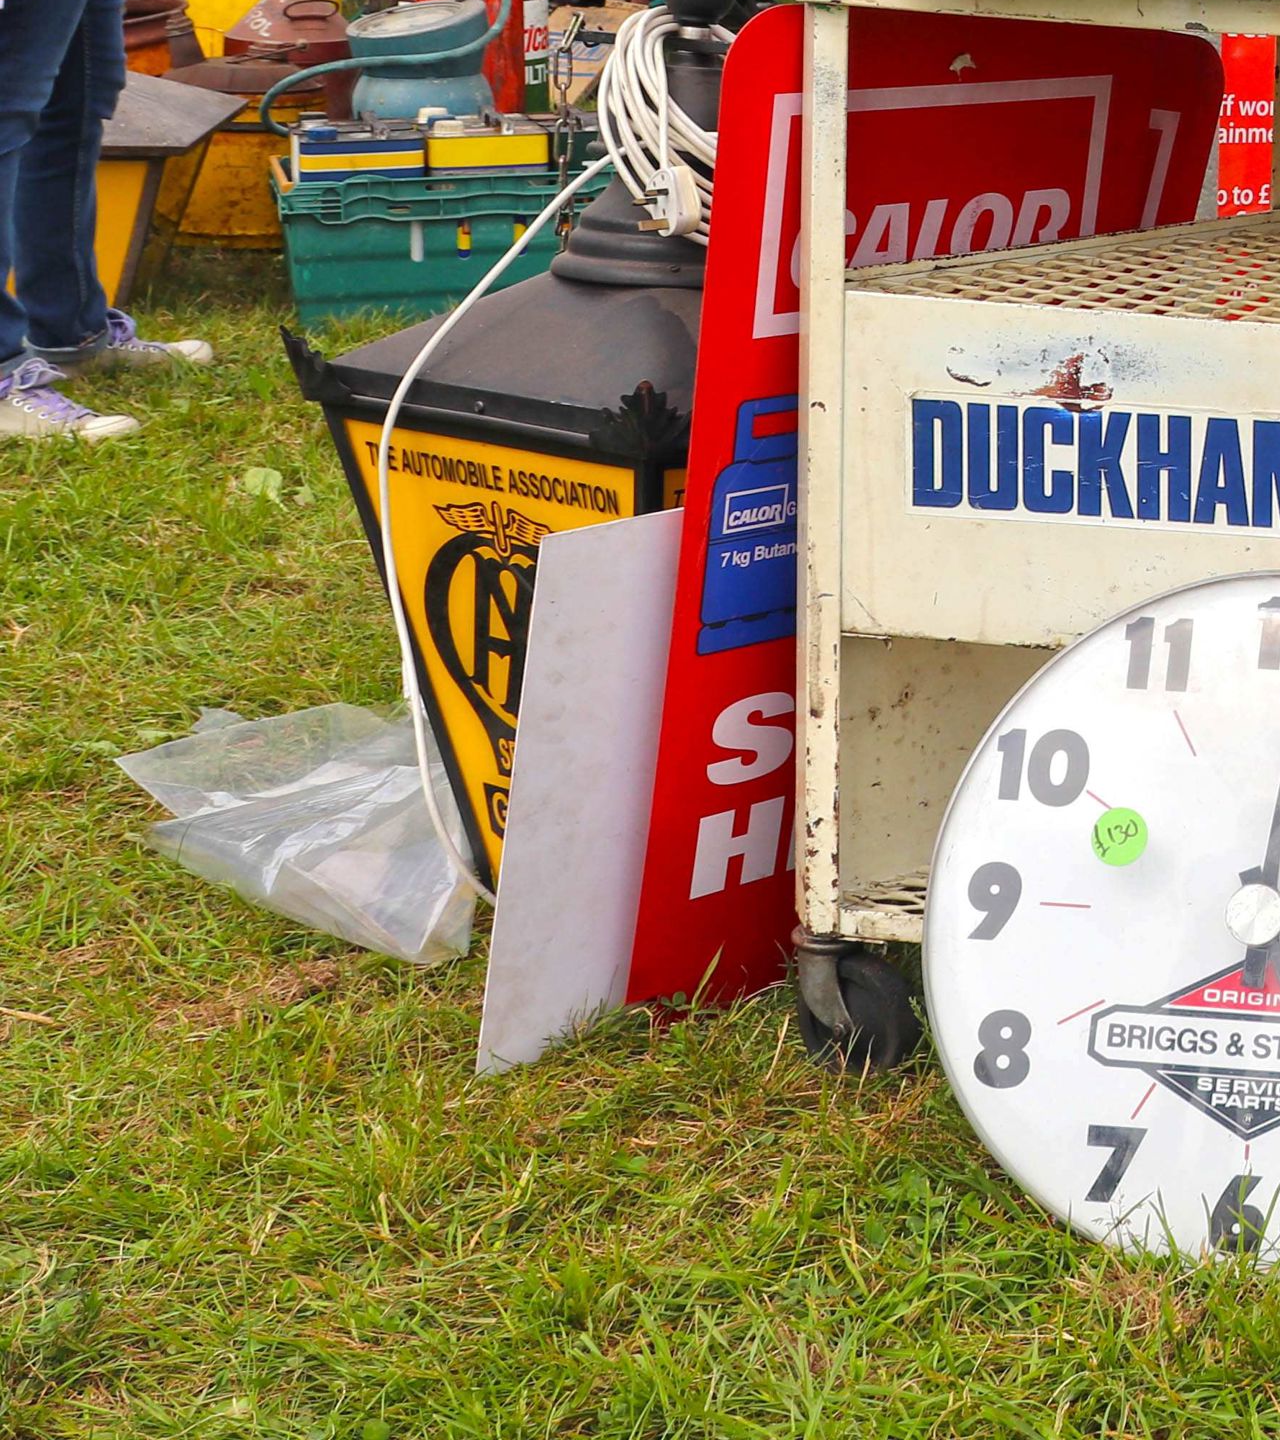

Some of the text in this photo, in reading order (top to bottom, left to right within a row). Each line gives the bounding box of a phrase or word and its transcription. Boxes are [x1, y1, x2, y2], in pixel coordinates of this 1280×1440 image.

[1232, 186, 1254, 205] to
[401, 449, 503, 492] AUTOMOBILE
[508, 468, 620, 515] ASSOCIATION
[729, 500, 782, 527] CALOR
[721, 540, 798, 570] 7 kg Butan
[1125, 616, 1194, 692] 11
[997, 728, 1090, 807] 10
[1094, 819, 1139, 858] £130
[967, 861, 1022, 941] 9
[974, 1009, 1030, 1089] 8
[1106, 1023, 1218, 1056] BRIGGS
[1225, 1033, 1245, 1057] &
[1085, 1124, 1148, 1203] 7
[1208, 1174, 1264, 1252] 6
